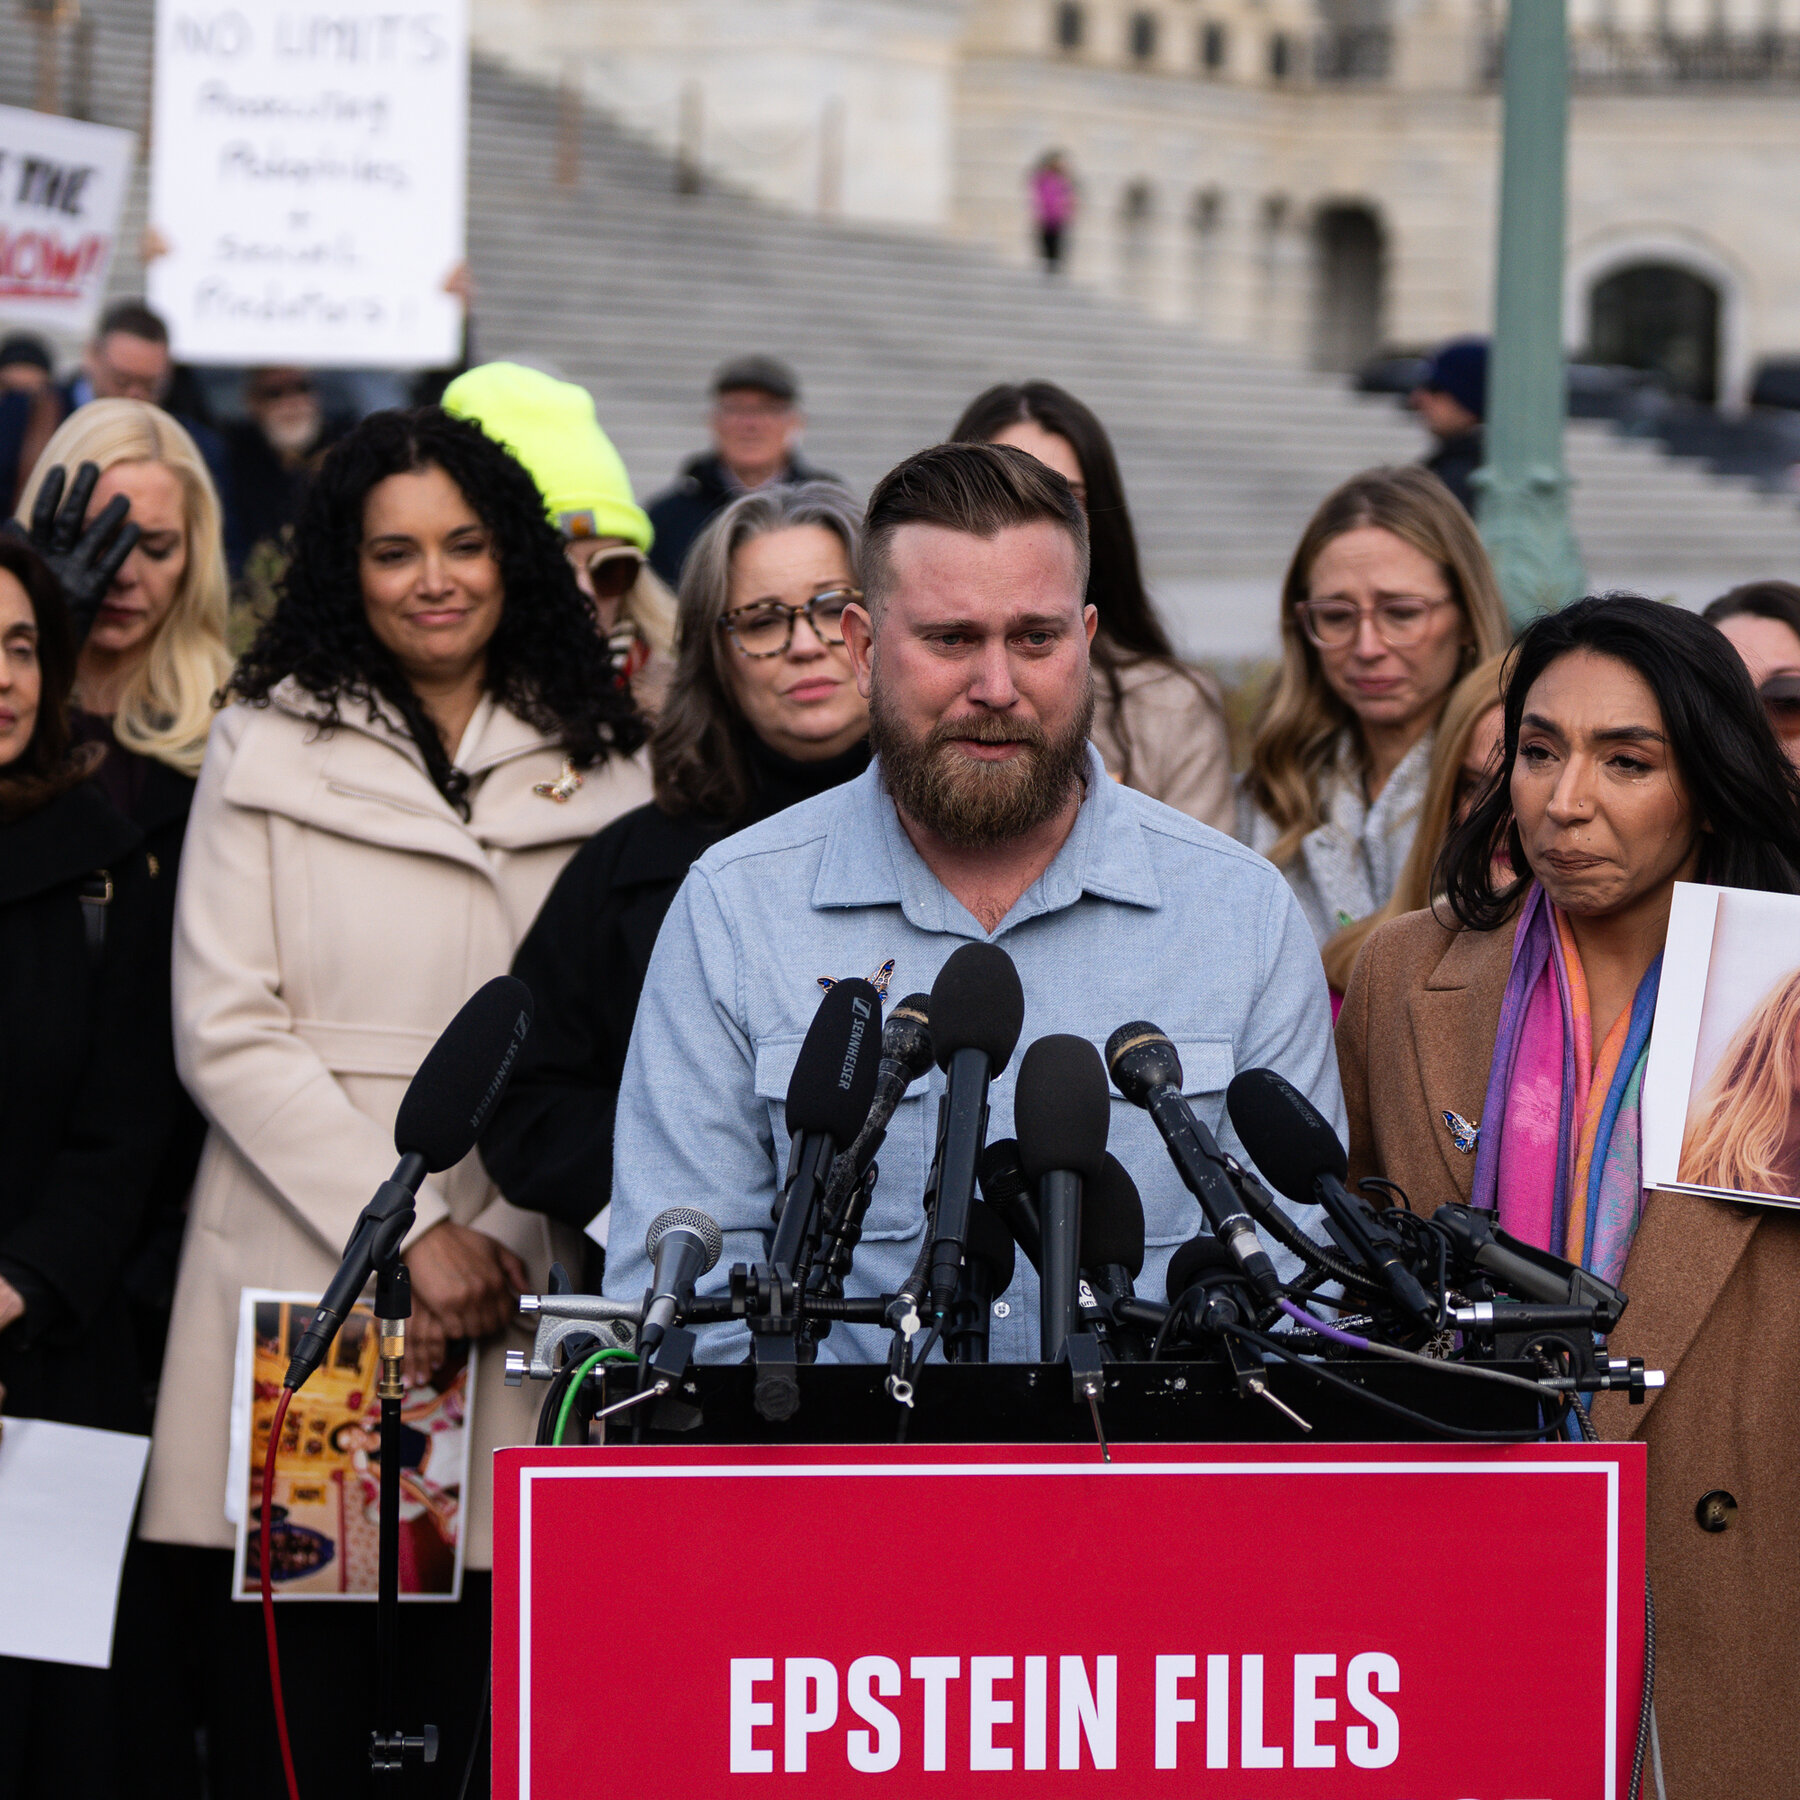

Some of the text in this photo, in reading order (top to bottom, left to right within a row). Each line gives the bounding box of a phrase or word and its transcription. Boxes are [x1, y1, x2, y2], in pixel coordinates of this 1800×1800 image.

[173, 9, 451, 63] NO LIMITS
[17, 153, 94, 217] THE
[470, 1039, 519, 1128] SENNHEISER
[838, 1018, 866, 1091] SENNHEISER
[730, 1653, 1400, 1773] EPSTEIN FILES
